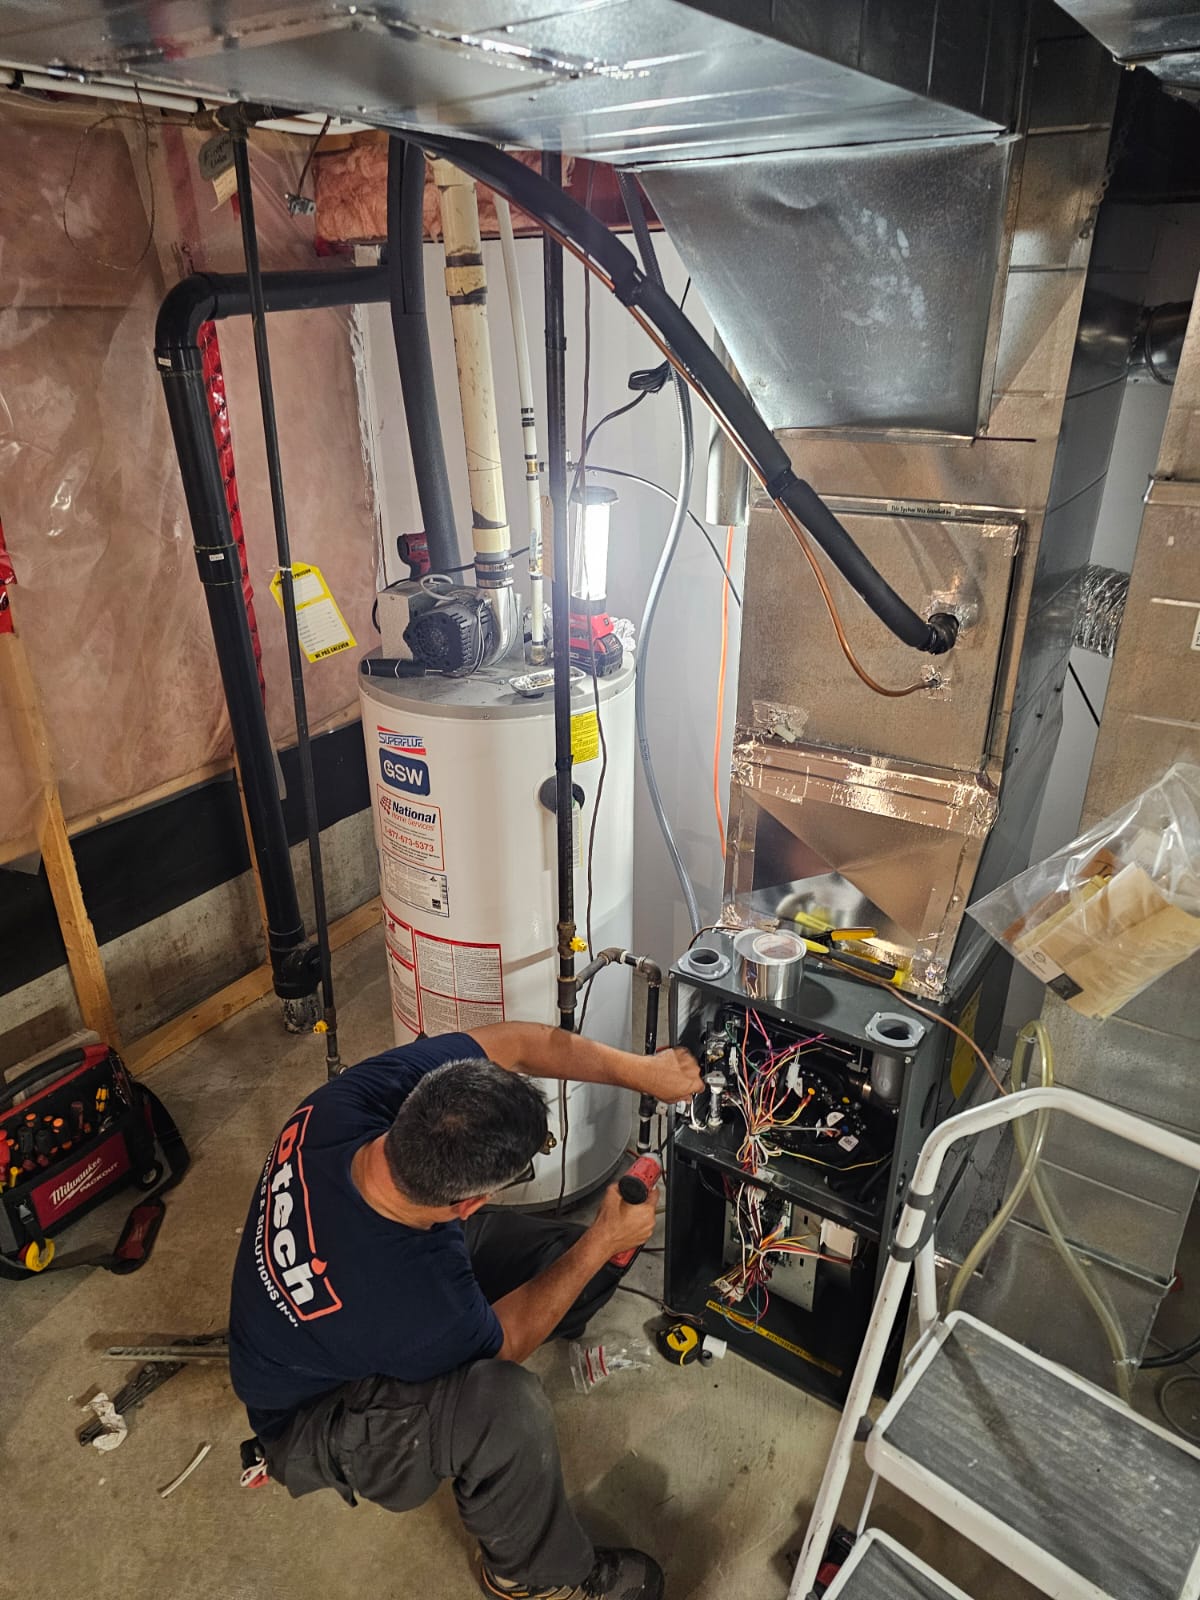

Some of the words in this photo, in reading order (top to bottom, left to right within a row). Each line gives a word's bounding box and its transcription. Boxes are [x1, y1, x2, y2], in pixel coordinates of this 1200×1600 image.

[378, 732, 424, 748] SUPERFLUE
[383, 759, 424, 787] GSW
[391, 812, 408, 824] Home
[407, 817, 435, 832] Services
[392, 802, 437, 824] National
[49, 1156, 102, 1206] Milwaukee
[79, 1161, 119, 1193] PACKOUT
[253, 1213, 281, 1303] SOLUTIONS
